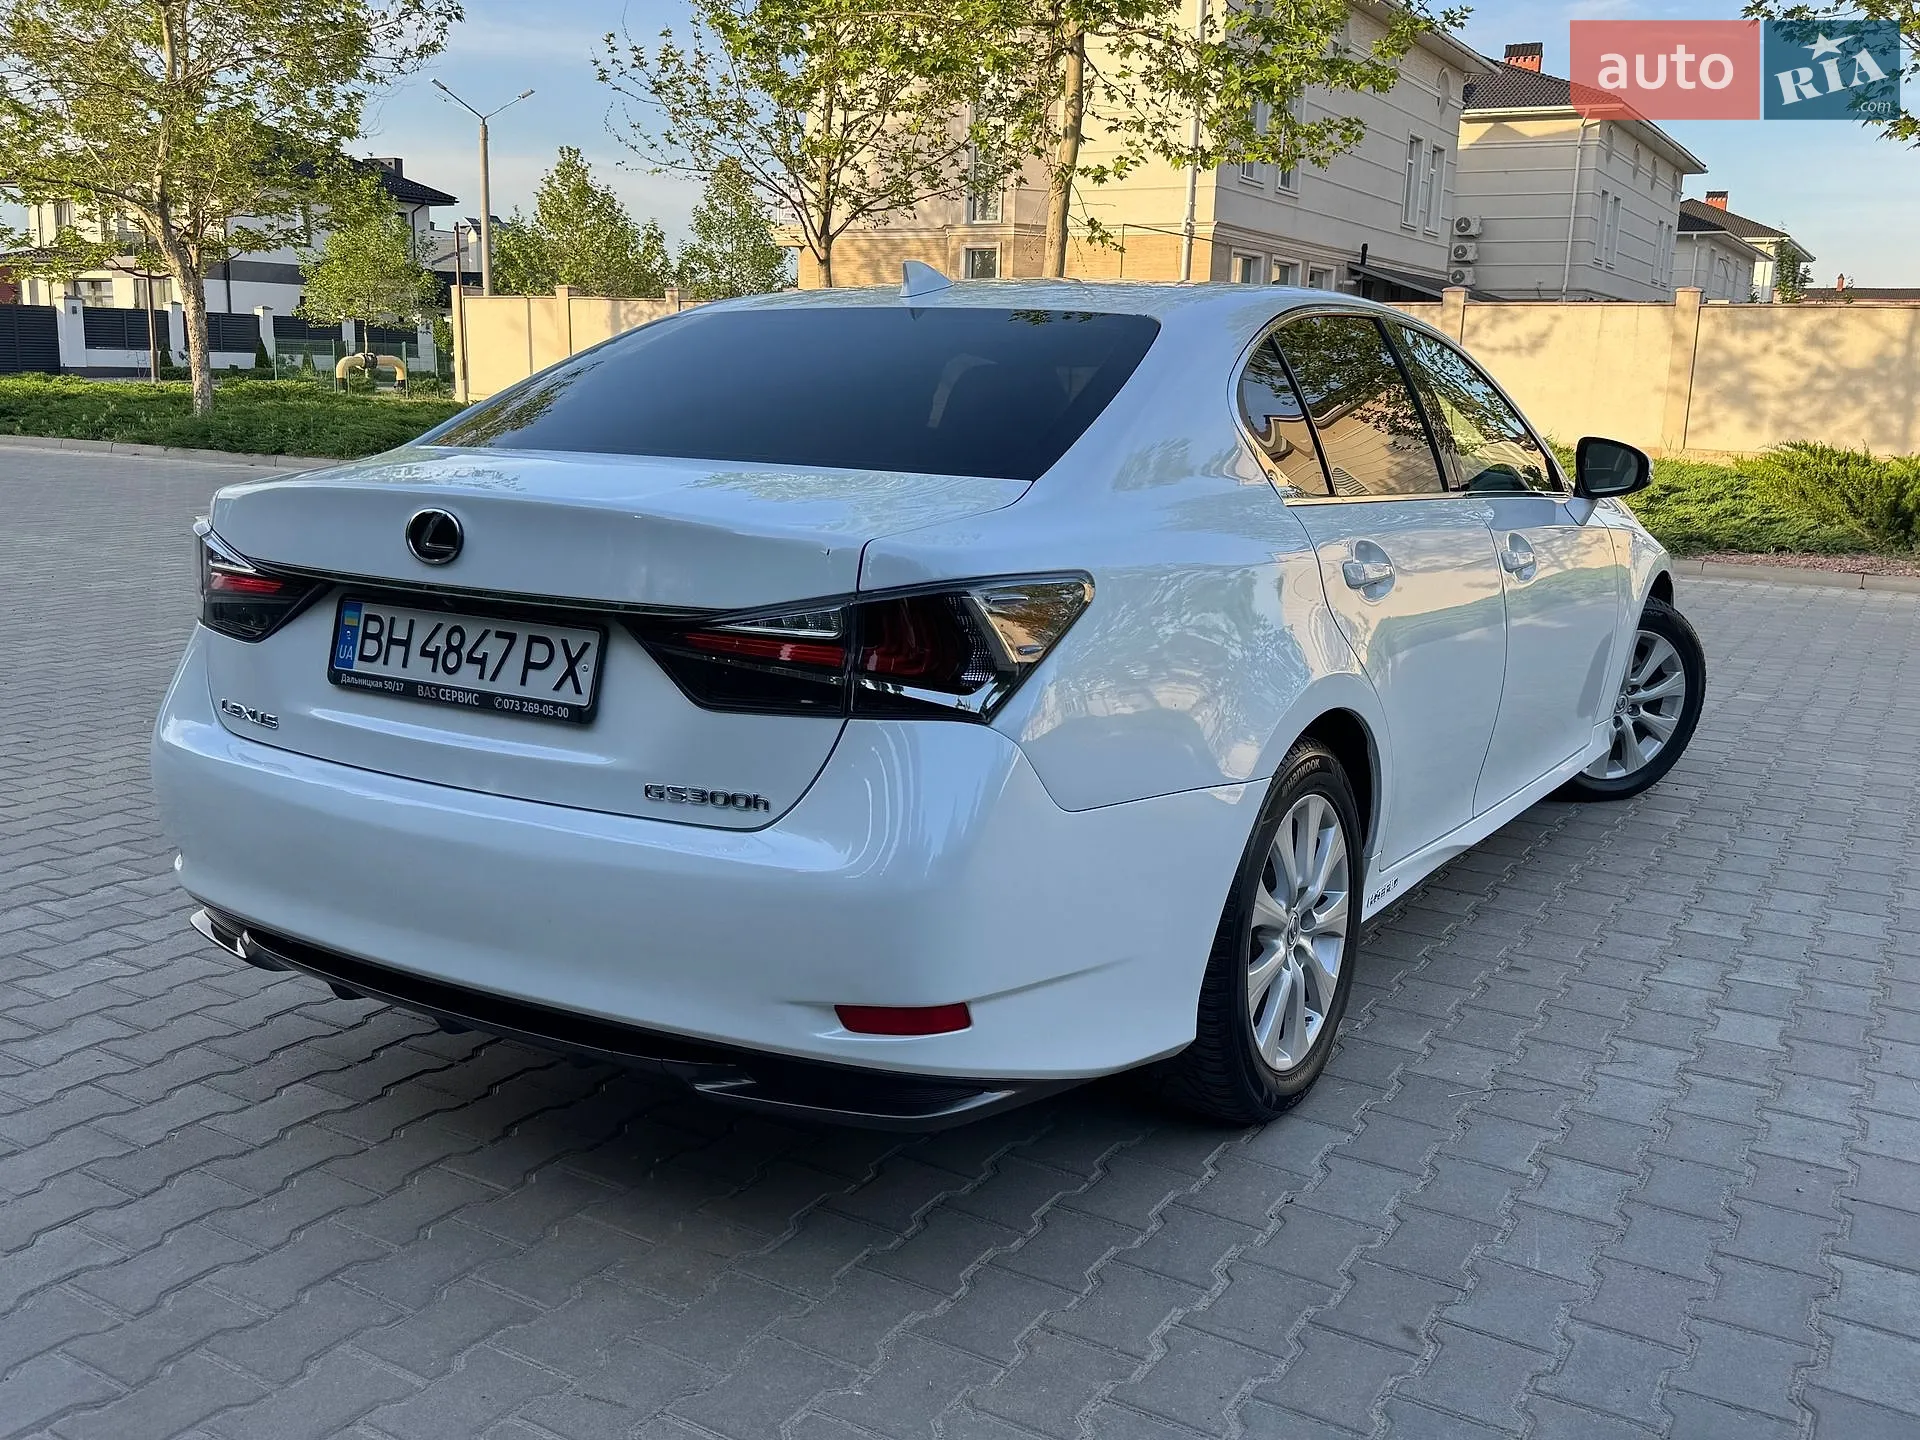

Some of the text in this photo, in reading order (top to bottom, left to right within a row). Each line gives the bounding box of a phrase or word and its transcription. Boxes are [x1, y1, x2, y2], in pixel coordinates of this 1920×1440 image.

[339, 644, 354, 661] UA
[358, 613, 591, 695] BH 4847 PX
[340, 673, 404, 692] Дальницкая 50/17
[417, 684, 480, 706] BAS СЕРВИС
[503, 699, 569, 718] 073 269-05-00
[644, 783, 770, 812] GS300h
